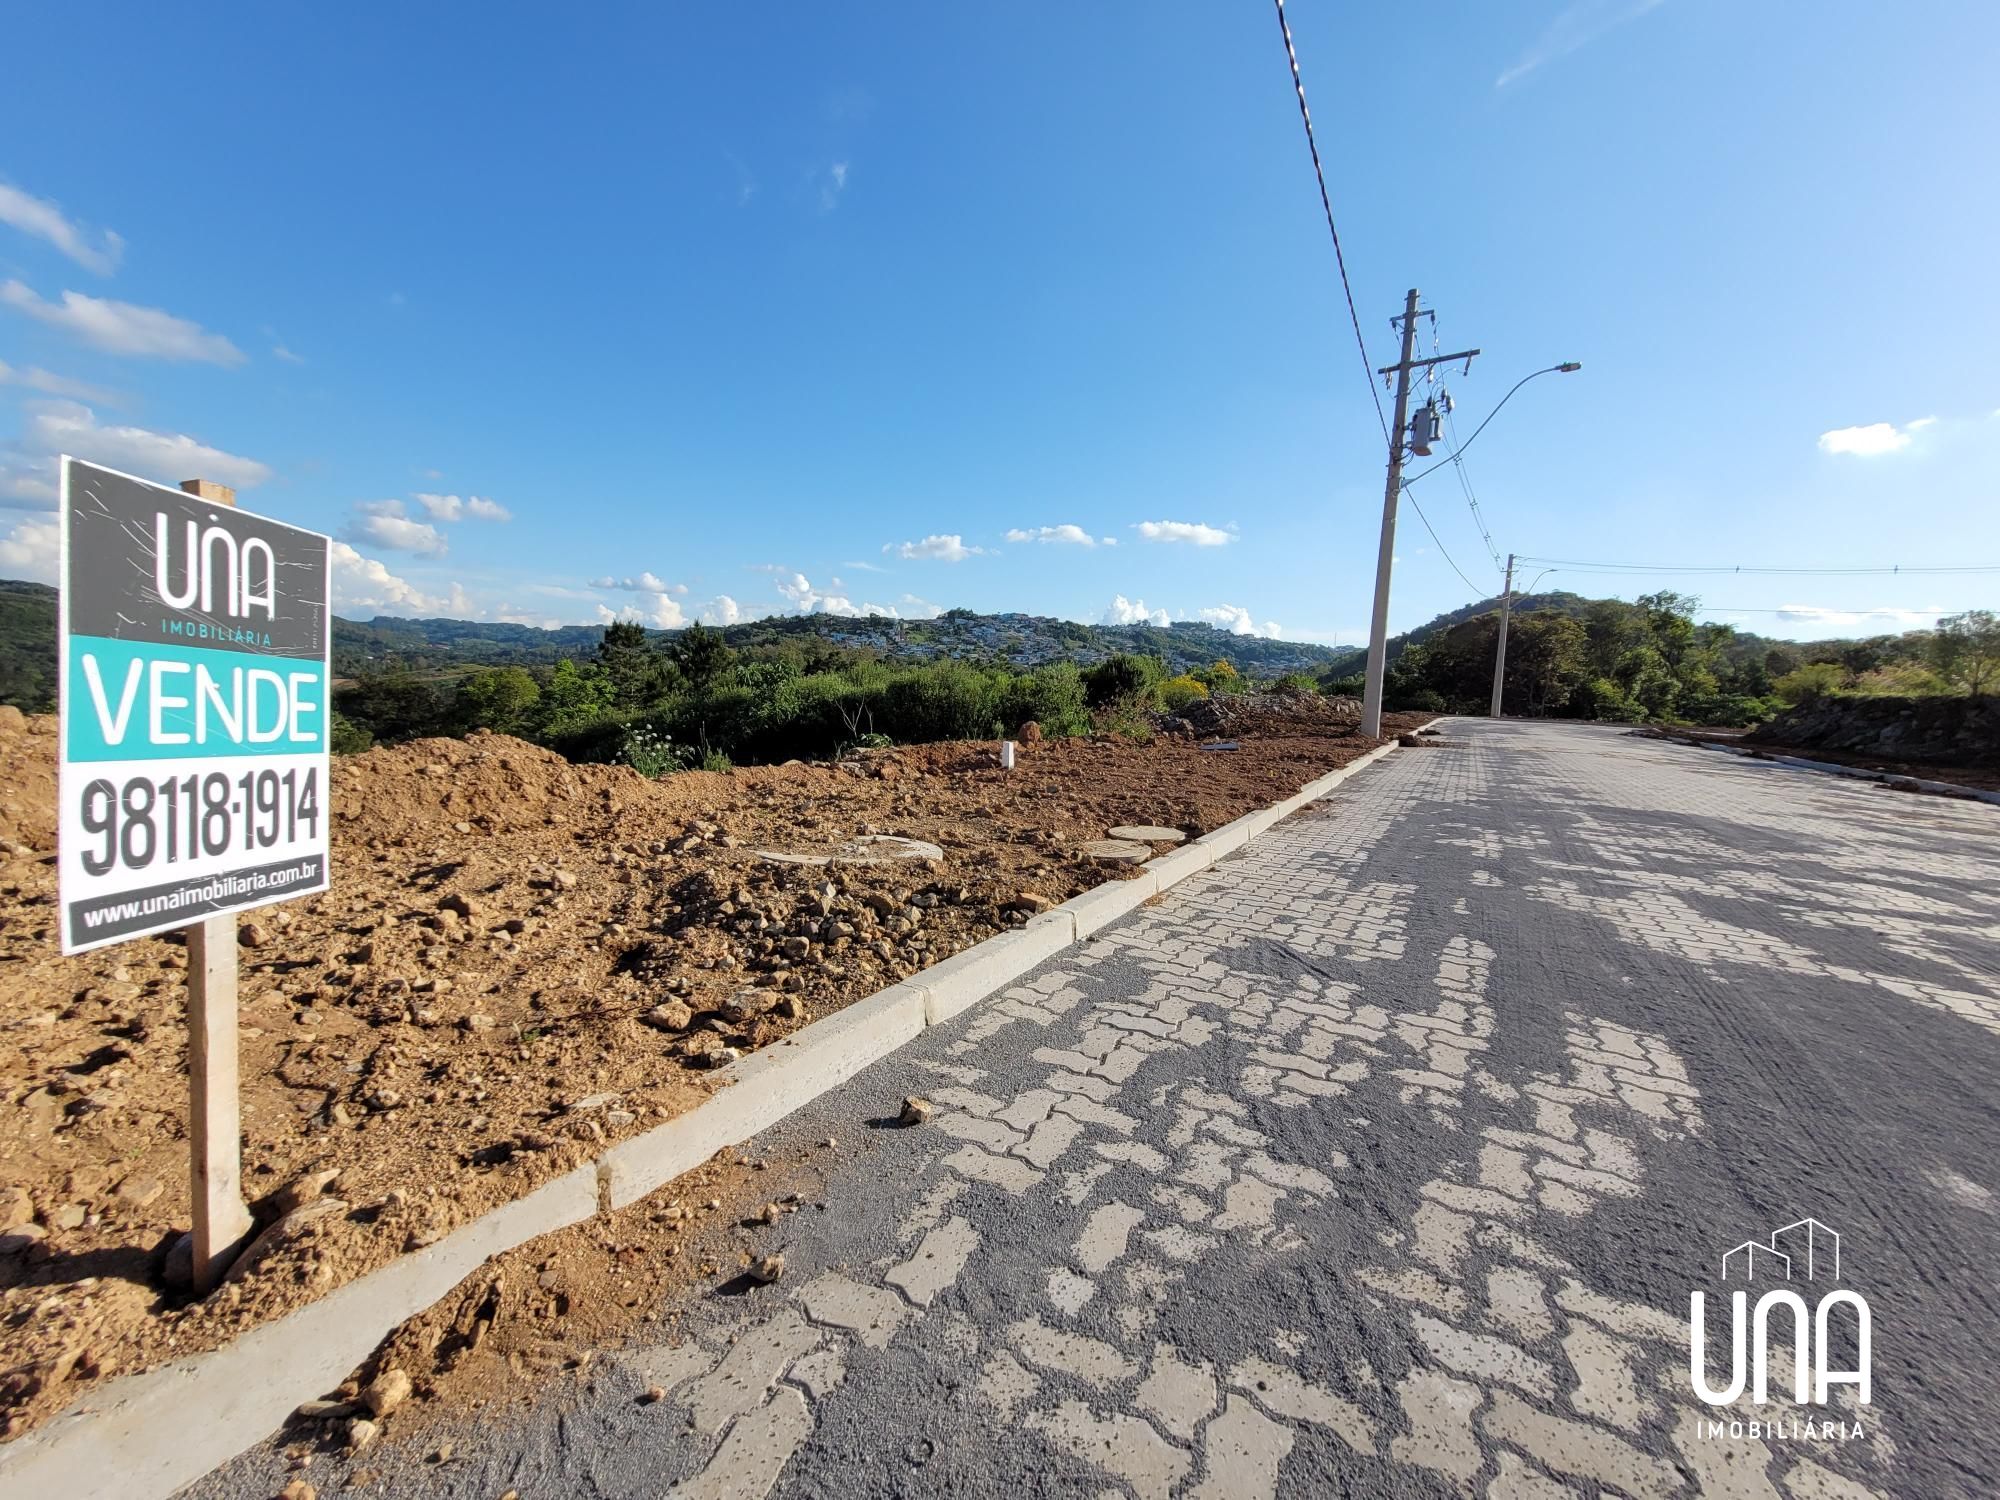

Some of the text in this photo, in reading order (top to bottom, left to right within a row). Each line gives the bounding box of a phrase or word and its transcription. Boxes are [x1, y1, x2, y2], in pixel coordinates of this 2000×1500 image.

[156, 512, 275, 621] UNA
[162, 618, 271, 646] IMOBILIÁRIA
[82, 653, 318, 745] VENDE
[80, 767, 318, 877] 98118-1914
[84, 862, 317, 928] www.unaimobiliaria.com.br
